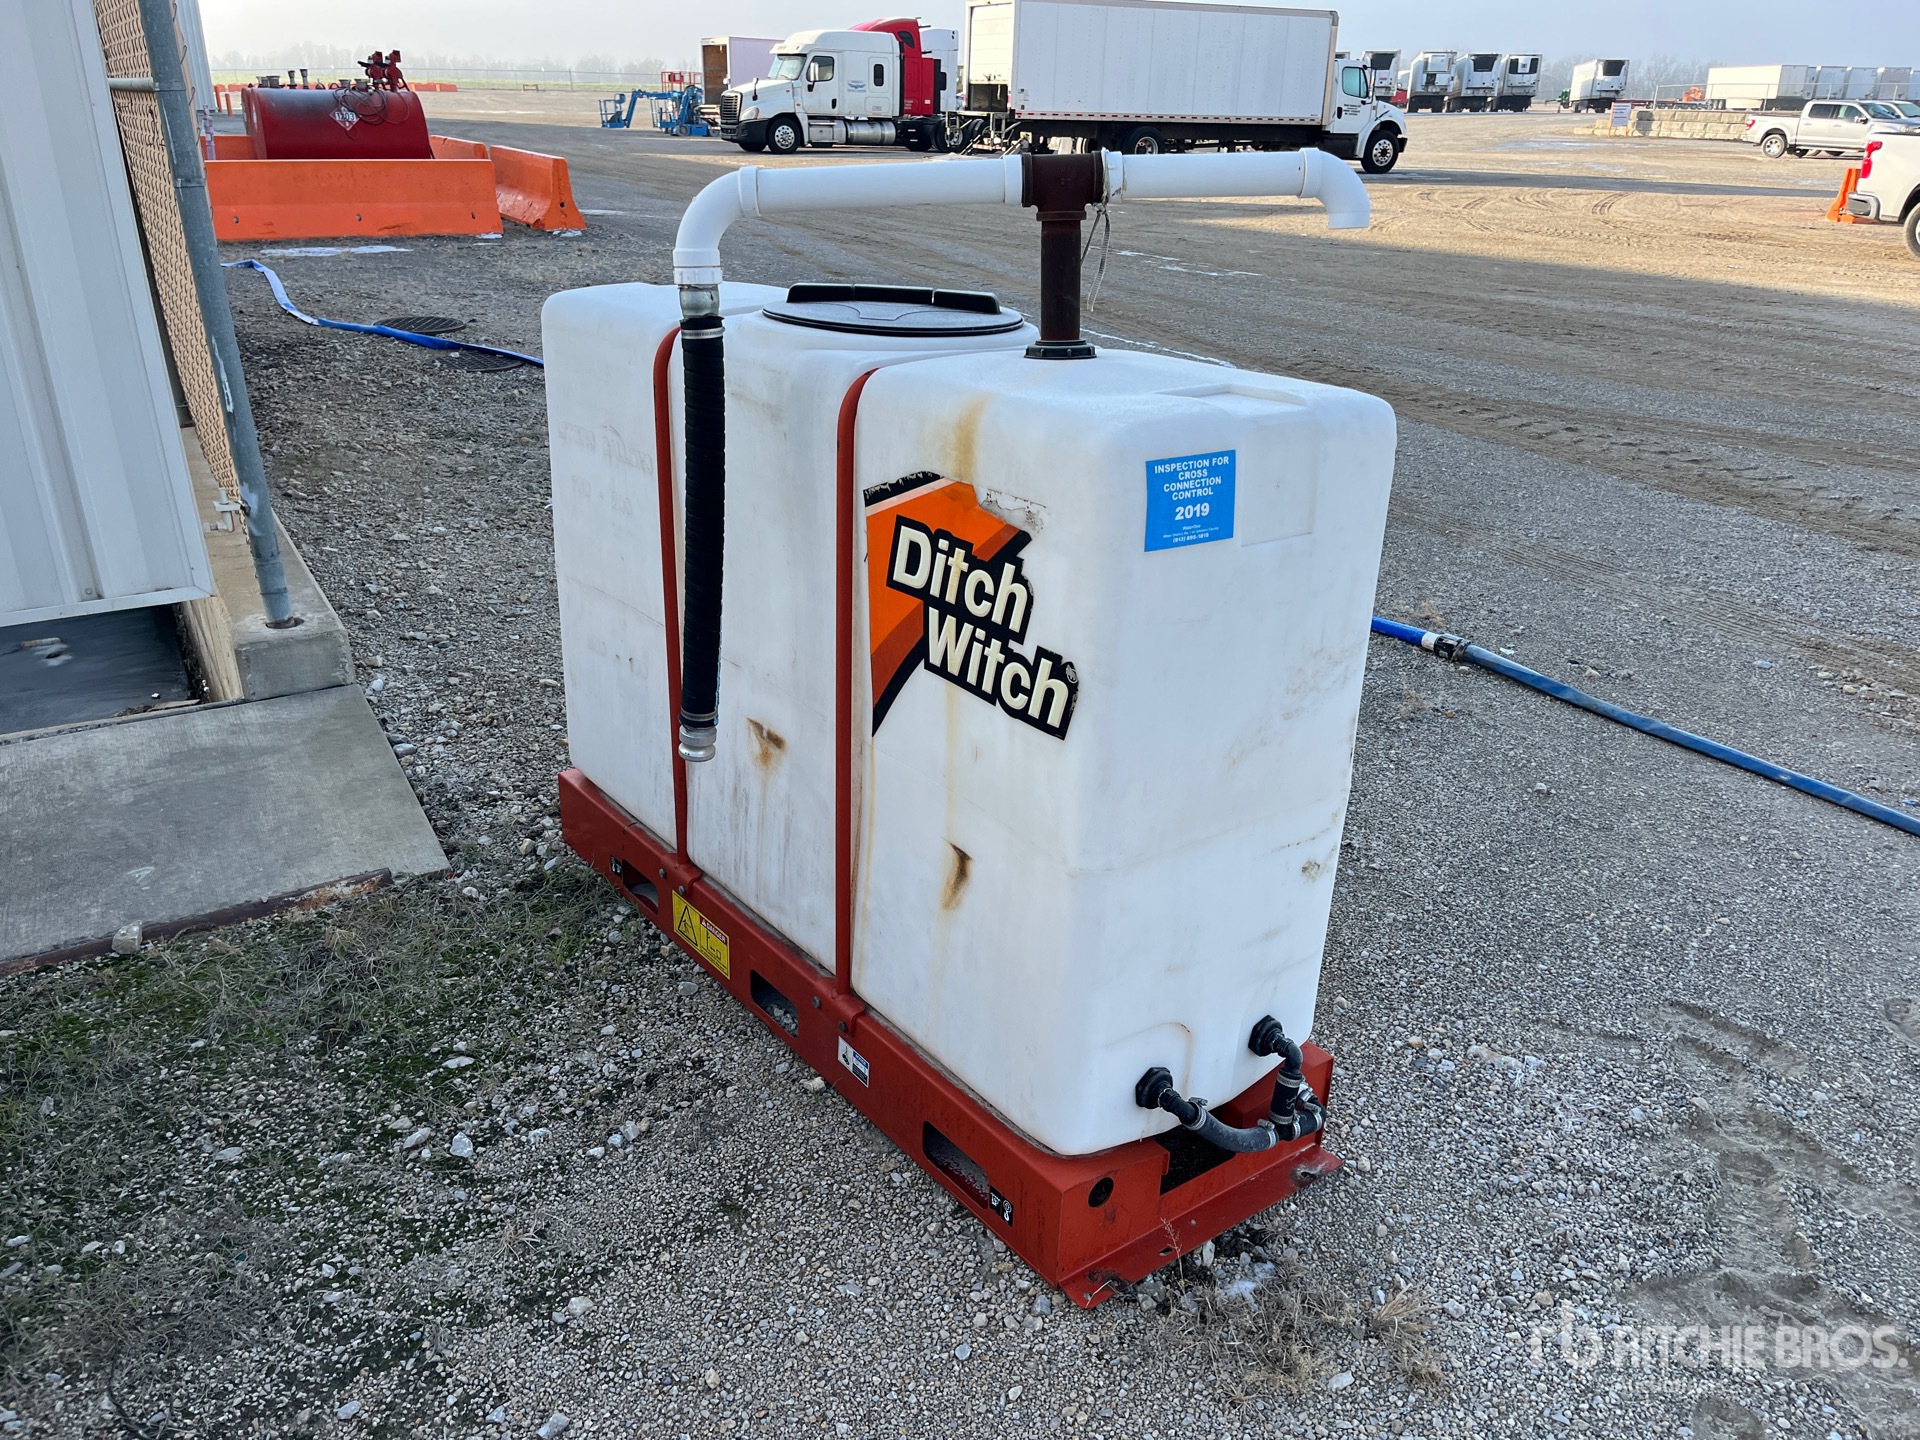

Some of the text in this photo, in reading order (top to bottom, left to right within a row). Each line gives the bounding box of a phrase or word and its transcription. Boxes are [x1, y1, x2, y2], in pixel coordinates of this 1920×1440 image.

[1154, 456, 1229, 474] INSPECTION FOR
[1178, 468, 1208, 480] CROSS
[1163, 476, 1222, 492] CONNECTION
[1172, 487, 1214, 500] CONTROL
[1174, 502, 1210, 521] 2019
[893, 525, 1028, 633] Ditch
[928, 606, 1069, 728] Witch
